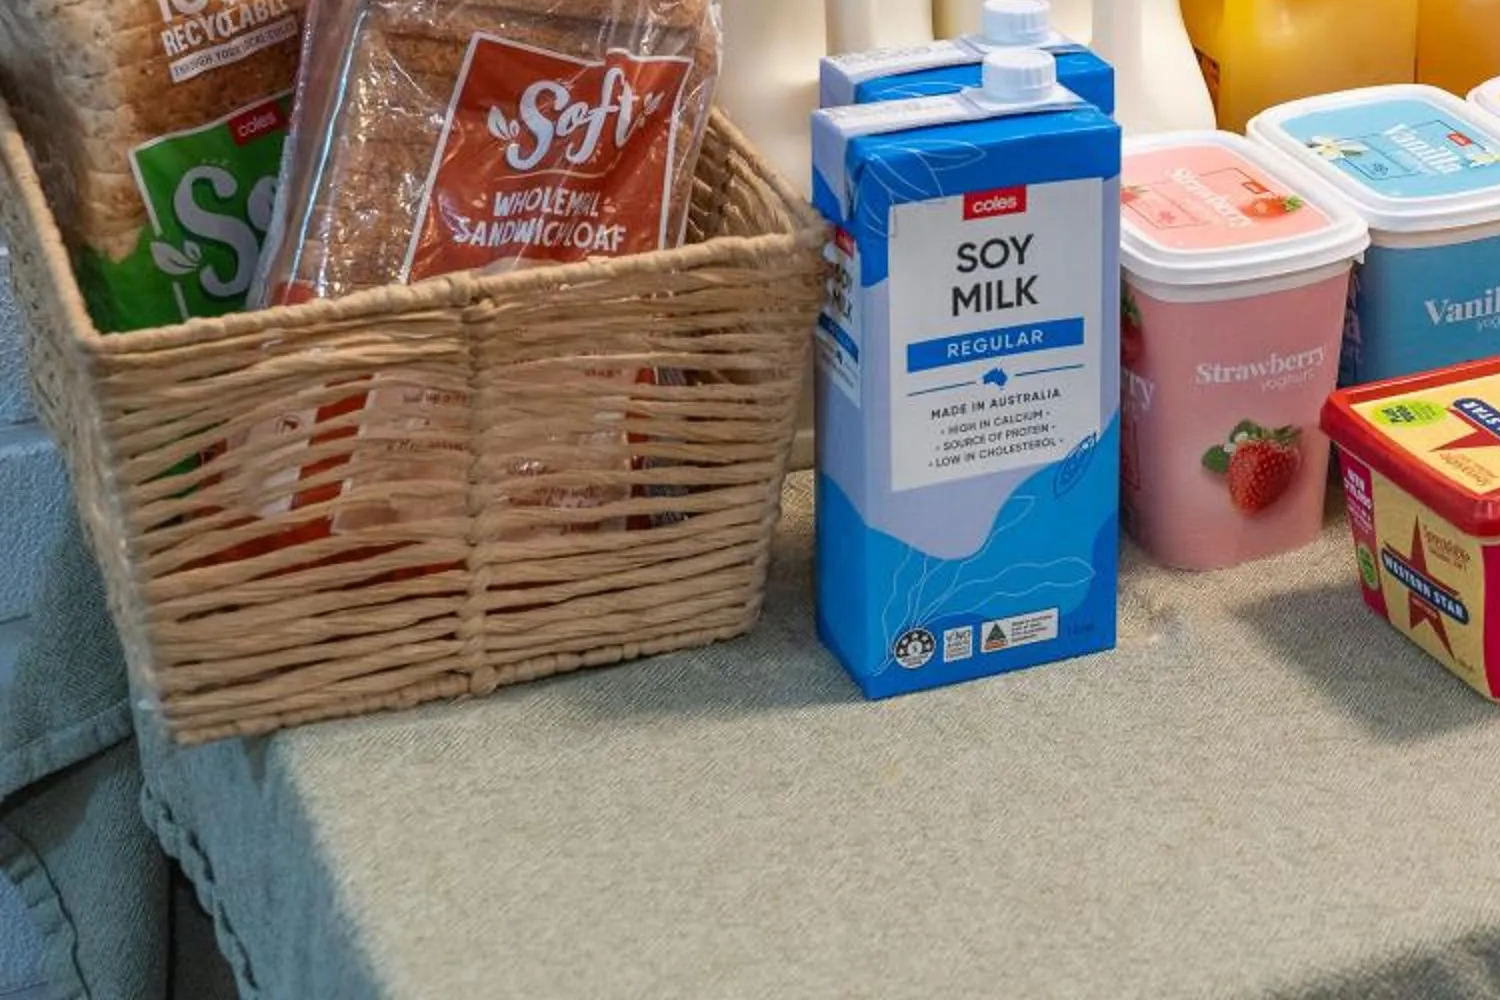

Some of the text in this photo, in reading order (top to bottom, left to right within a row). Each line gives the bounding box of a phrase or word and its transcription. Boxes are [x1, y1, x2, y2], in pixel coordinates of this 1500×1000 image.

[506, 67, 640, 170] Soft
[972, 195, 1018, 214] coles
[173, 165, 279, 297] So
[956, 233, 1034, 273] SOY
[952, 275, 1040, 317] MILK
[947, 329, 1044, 359] REGULAR
[1194, 343, 1328, 386] Strawberry
[931, 388, 1062, 420] MADE IN AUSTRALIA
[979, 417, 991, 429] IN
[993, 410, 1043, 427] CALCIUM
[935, 437, 1057, 468] LOW IN CHOLESTEROL
[943, 424, 1049, 451] SOURCE OF PROTEIN
[1384, 552, 1431, 598] WESTERN
[1432, 590, 1464, 618] STAR
